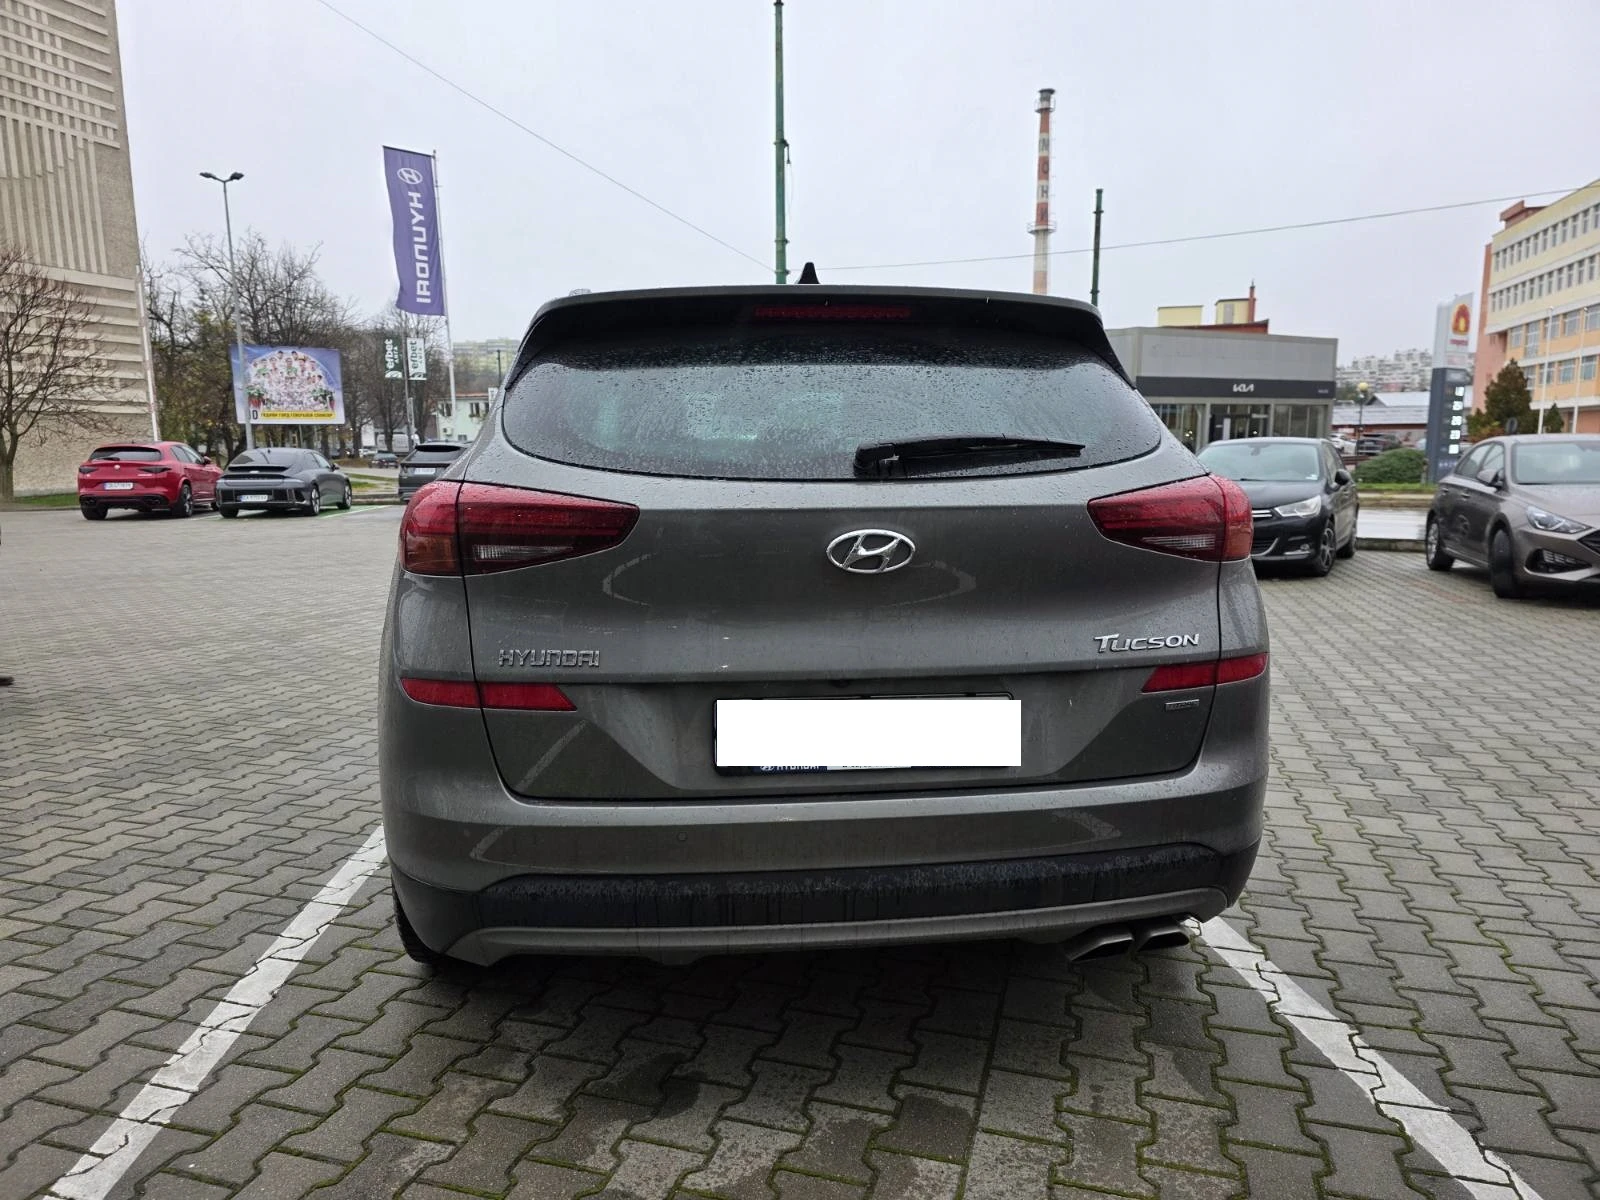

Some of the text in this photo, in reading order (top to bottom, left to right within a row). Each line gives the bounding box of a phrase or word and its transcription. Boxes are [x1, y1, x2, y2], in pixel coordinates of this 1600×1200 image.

[384, 339, 394, 369] efbet
[1232, 383, 1255, 393] KIA
[499, 649, 600, 667] HYUNDAI
